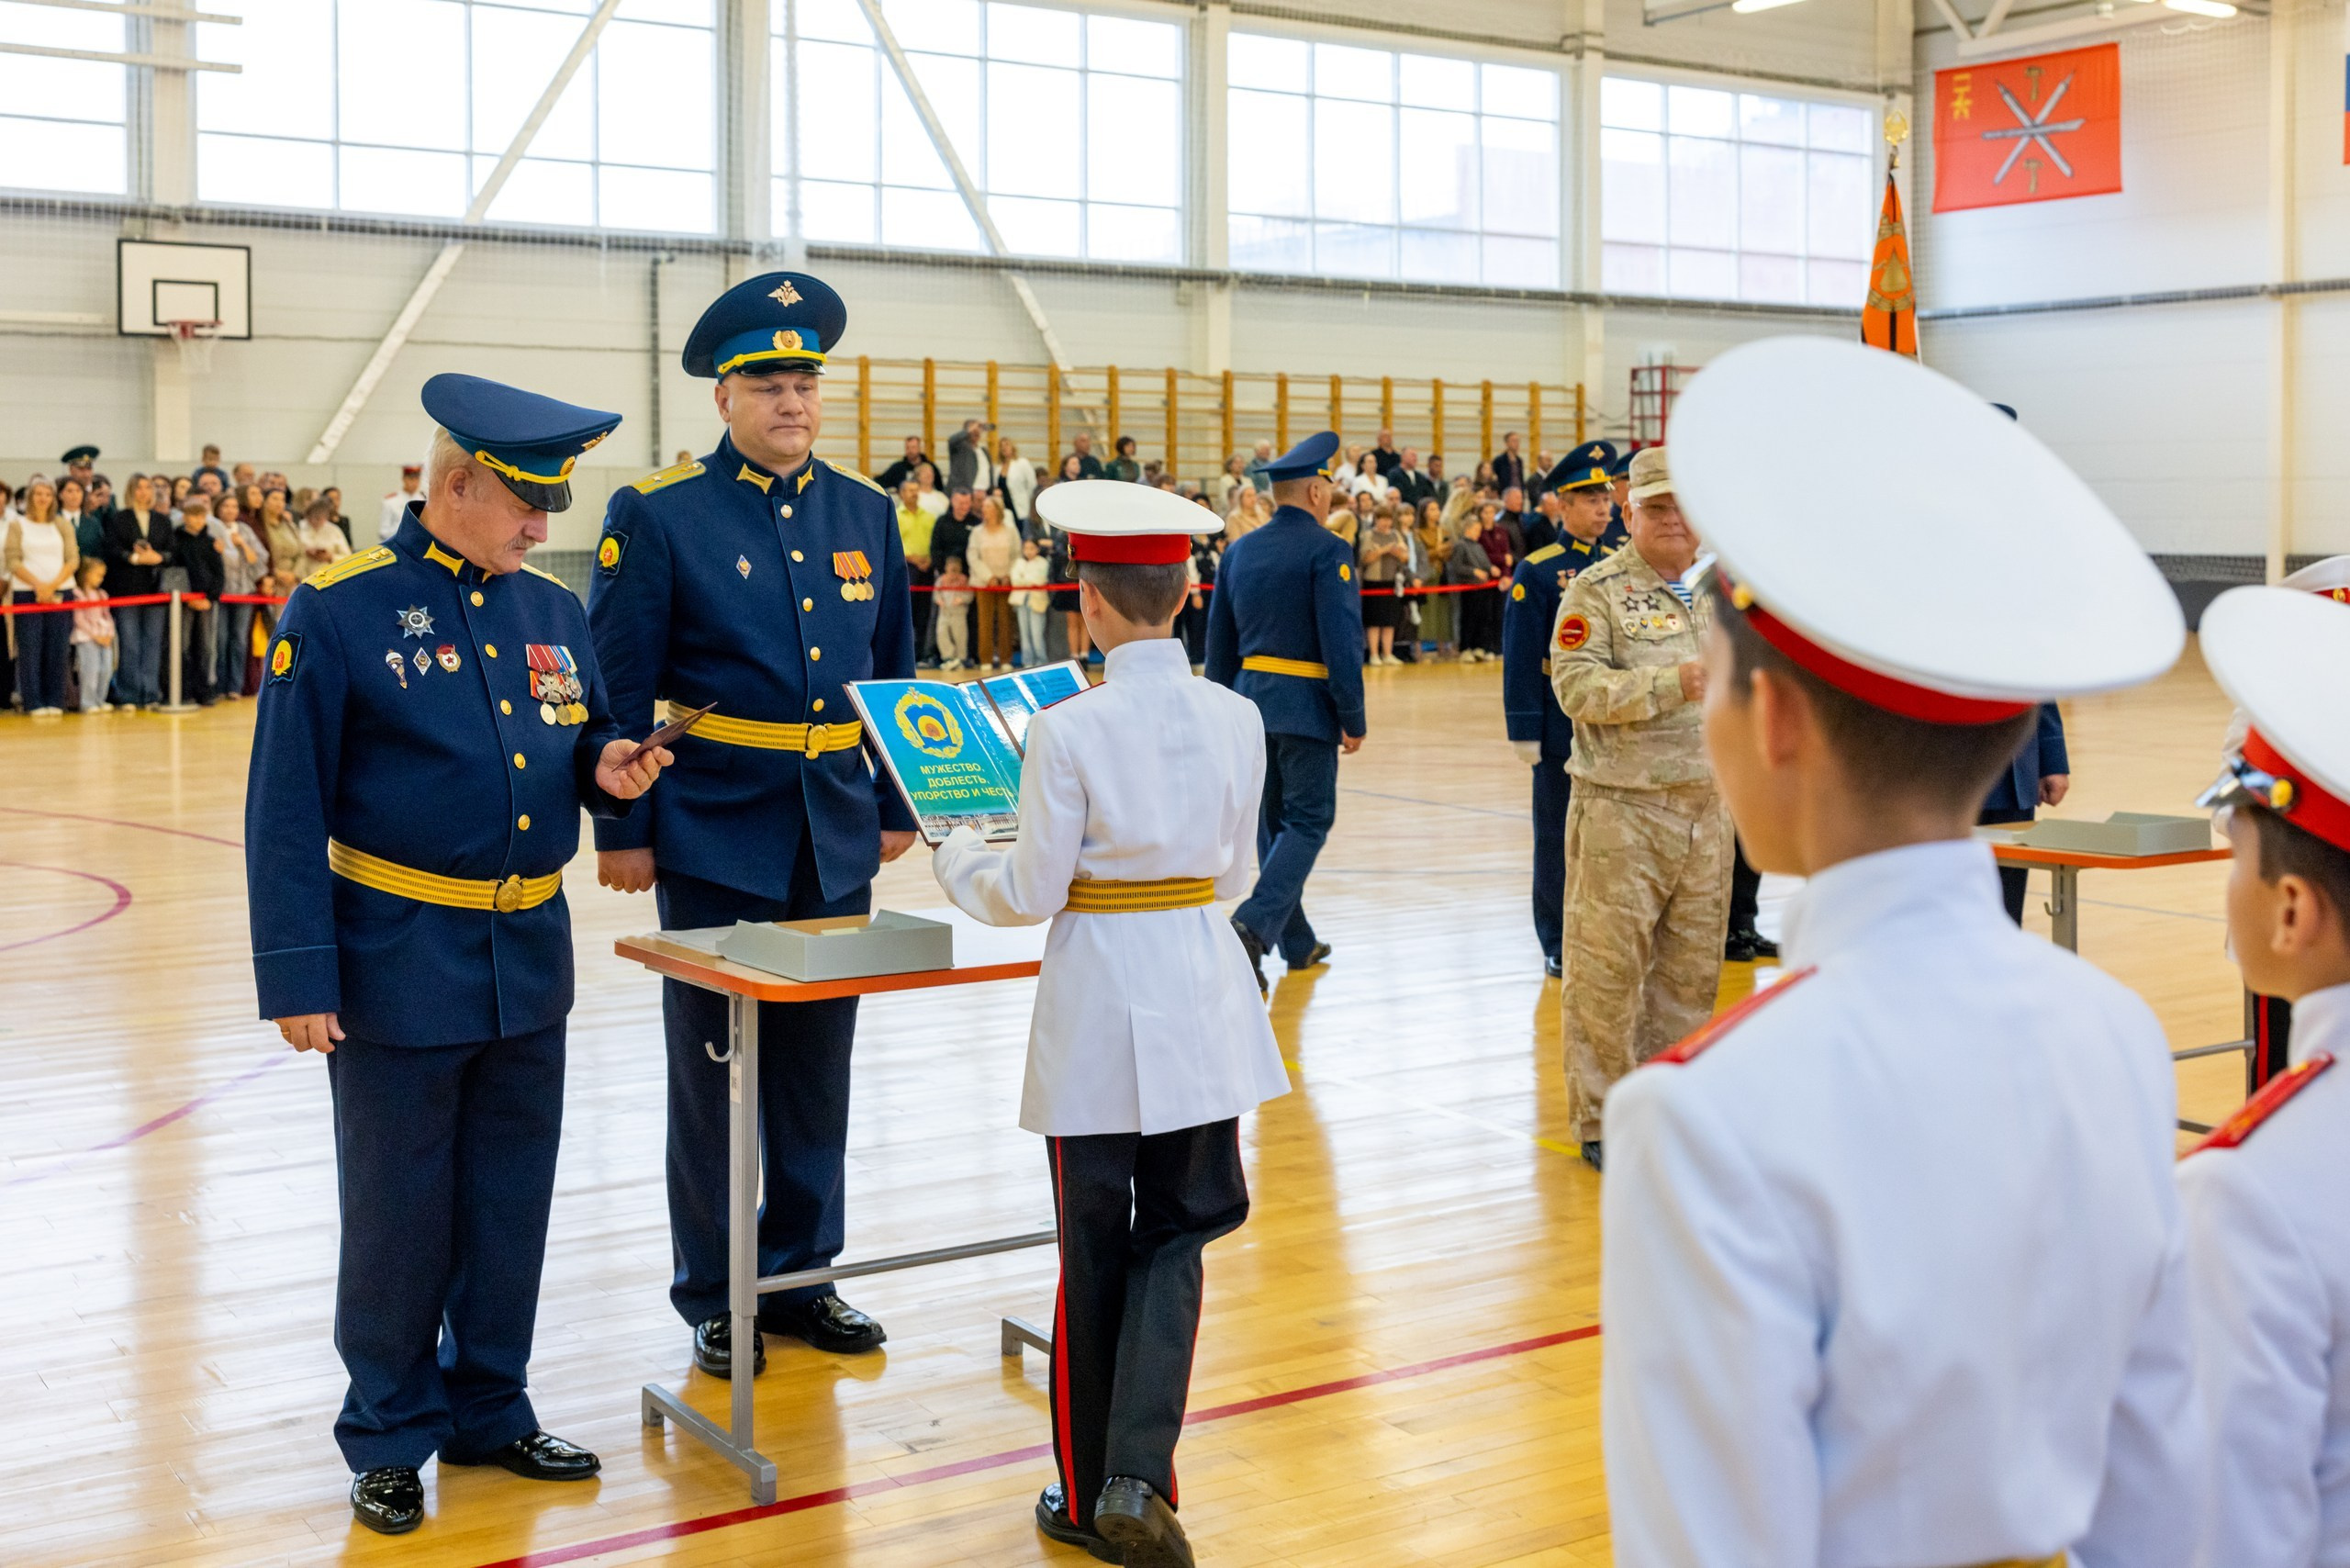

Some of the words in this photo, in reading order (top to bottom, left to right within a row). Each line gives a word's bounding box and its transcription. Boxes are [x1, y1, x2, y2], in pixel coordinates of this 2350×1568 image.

[920, 762, 985, 775] МУЖЕСТВО,
[927, 775, 990, 789] ДОБЛЕСТЬ,
[910, 789, 969, 801] УПОРСТВО
[971, 788, 980, 798] И
